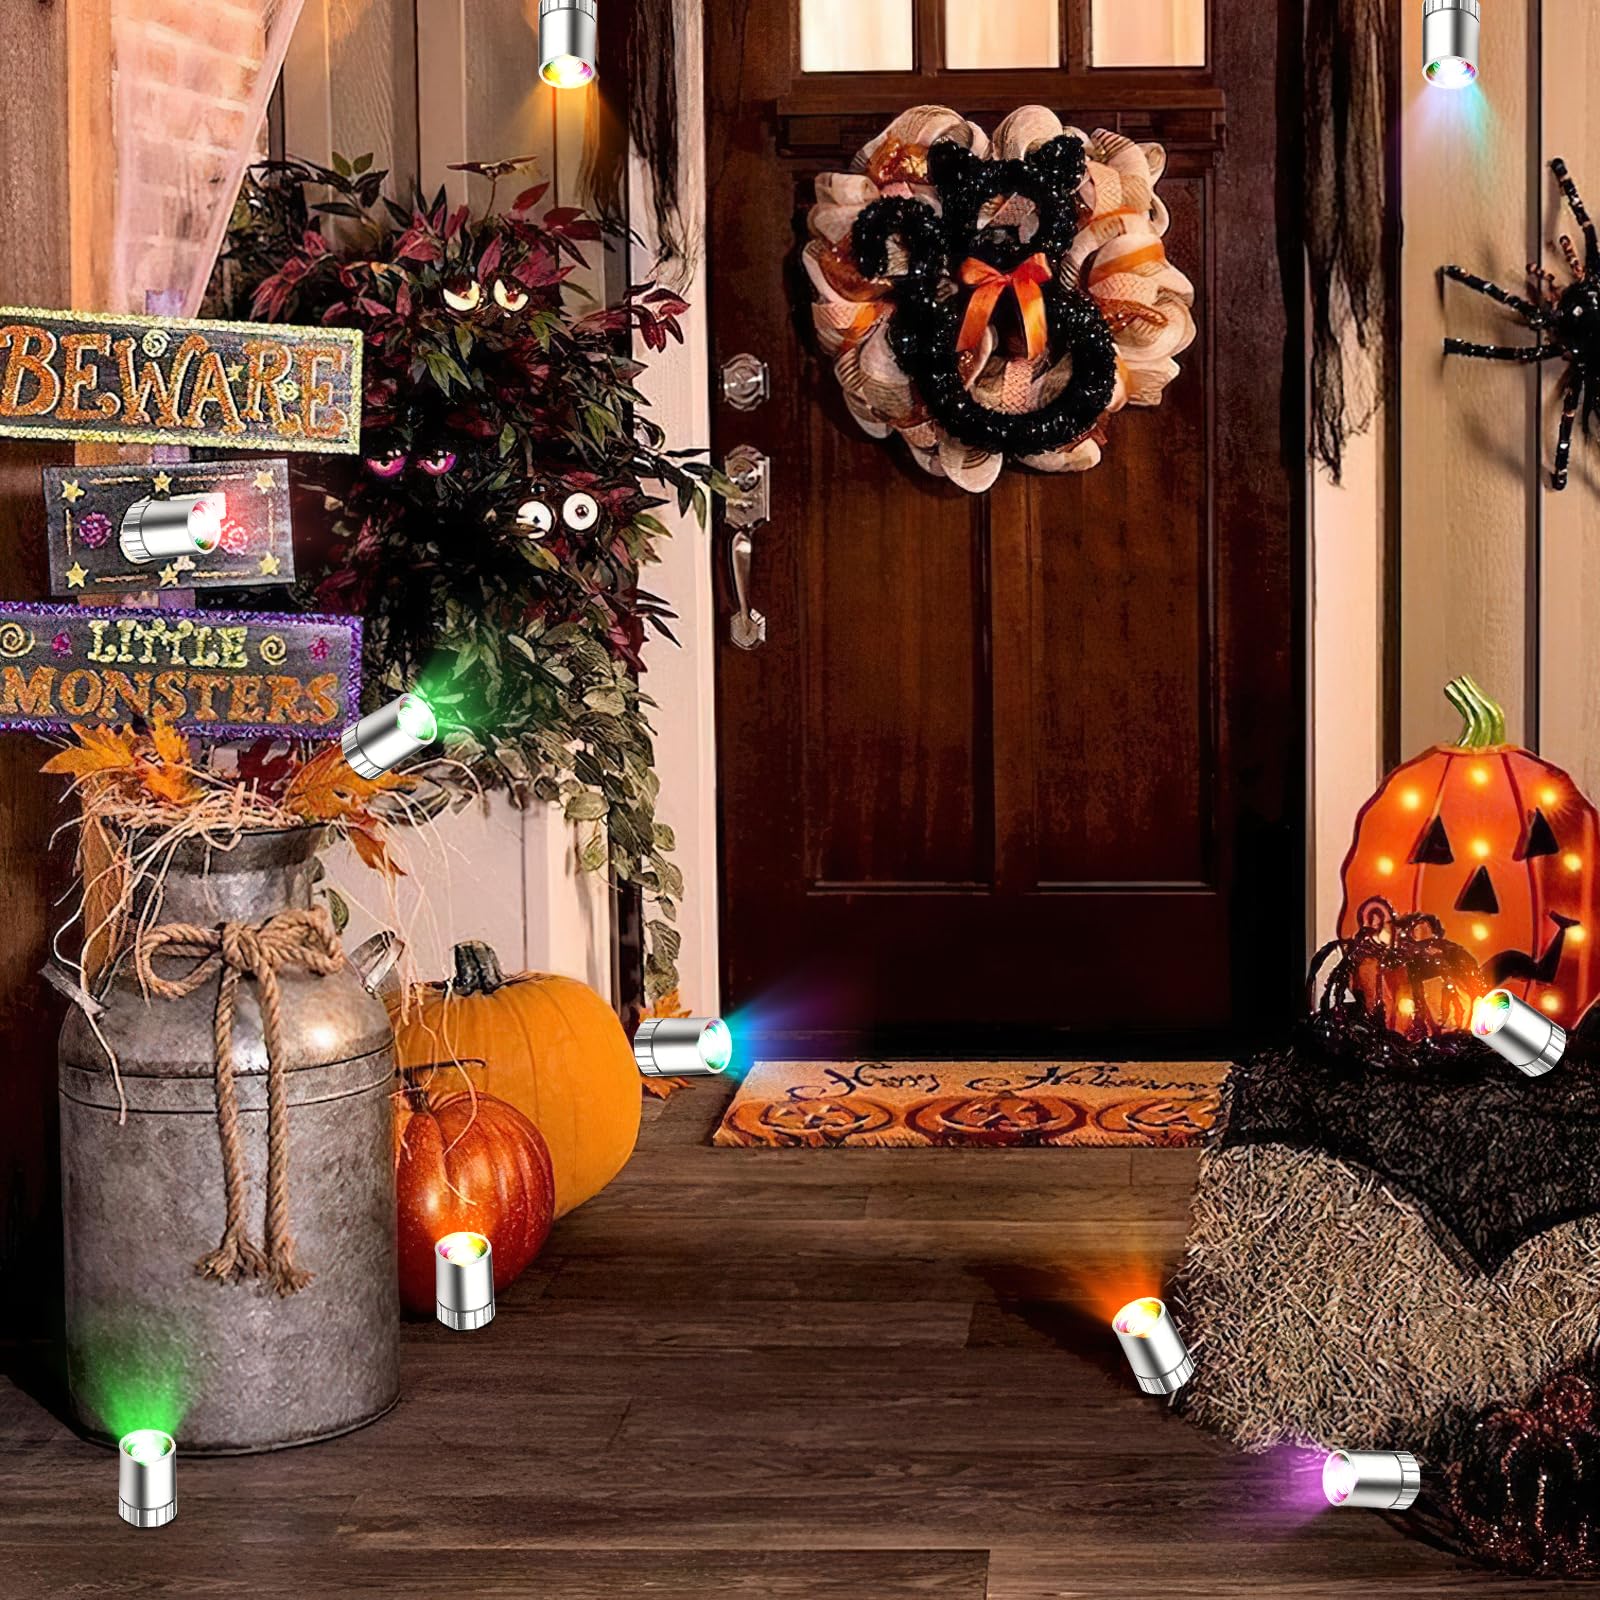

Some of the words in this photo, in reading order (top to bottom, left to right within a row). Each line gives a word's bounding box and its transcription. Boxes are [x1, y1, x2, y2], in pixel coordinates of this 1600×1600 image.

[0, 325, 347, 438] BEWARE
[87, 618, 249, 667] LITTLE
[0, 666, 341, 724] MONSTERS
